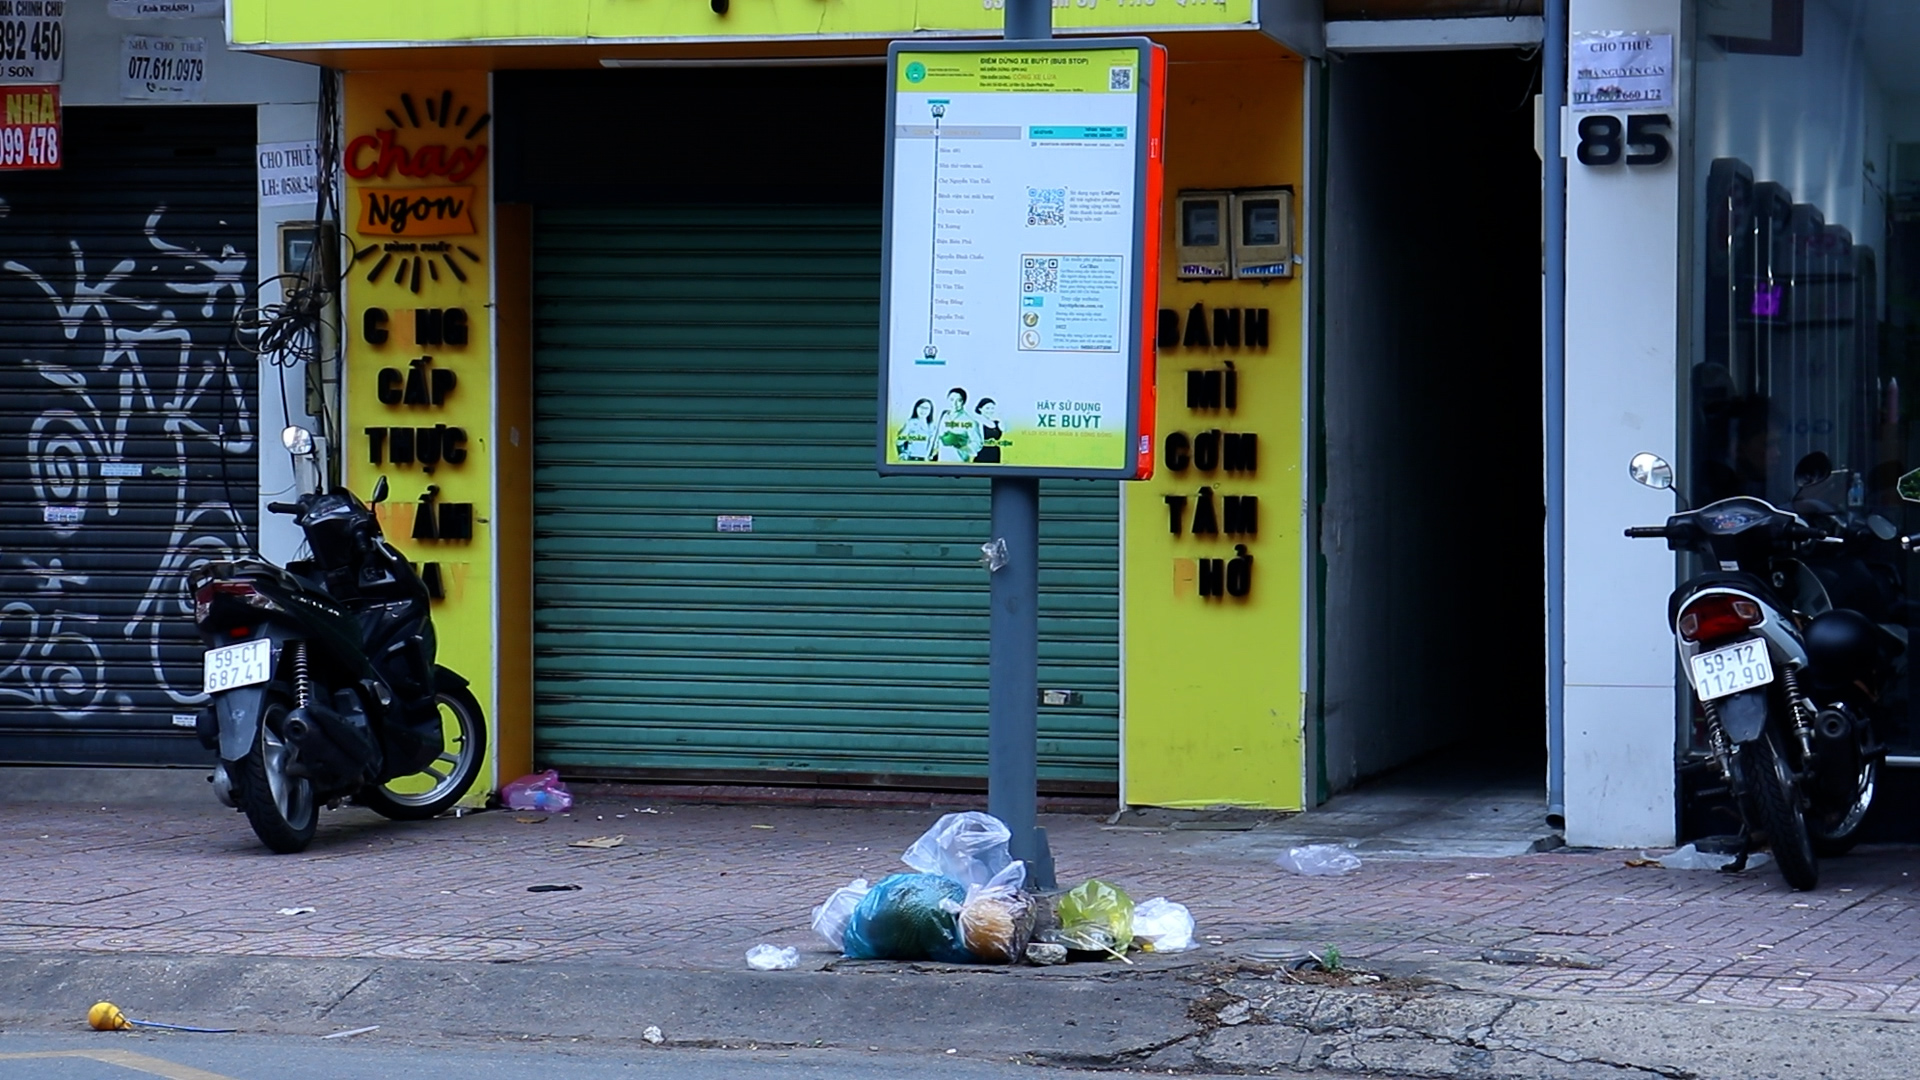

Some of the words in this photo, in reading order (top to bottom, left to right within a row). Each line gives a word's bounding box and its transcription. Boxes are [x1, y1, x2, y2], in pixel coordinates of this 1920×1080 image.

[31, 21, 61, 60] 450
[154, 41, 174, 51] CHO
[1590, 42, 1617, 52] CHO
[1620, 38, 1653, 51] THUÊ
[8, 65, 34, 77] SƠN
[128, 56, 203, 81] 077.611.0979
[1031, 56, 1049, 64] BUÝT
[1601, 65, 1641, 77] NGUYÊN
[6, 88, 56, 124] NHÀ
[28, 127, 57, 165] 478
[344, 128, 489, 183] Chay
[1577, 113, 1672, 166] 85
[260, 150, 283, 169] CHO
[284, 144, 313, 167] THUÊ
[261, 178, 280, 197] LH:
[368, 192, 464, 234] Ngon
[1158, 302, 1270, 347] BÁNH
[377, 354, 458, 405] CẤP
[1186, 361, 1238, 409] MÌ
[1037, 399, 1057, 410] HÃY
[1059, 399, 1072, 411] SỬ
[1074, 402, 1101, 413] DỤNG
[1037, 414, 1056, 427] XE
[1061, 411, 1102, 428] BUÝT
[364, 424, 468, 474] THỰC
[1163, 429, 1258, 472] CƠM
[215, 643, 259, 669] 59-C1
[1703, 645, 1756, 675] 59-T2
[1701, 662, 1767, 697] 112.90
